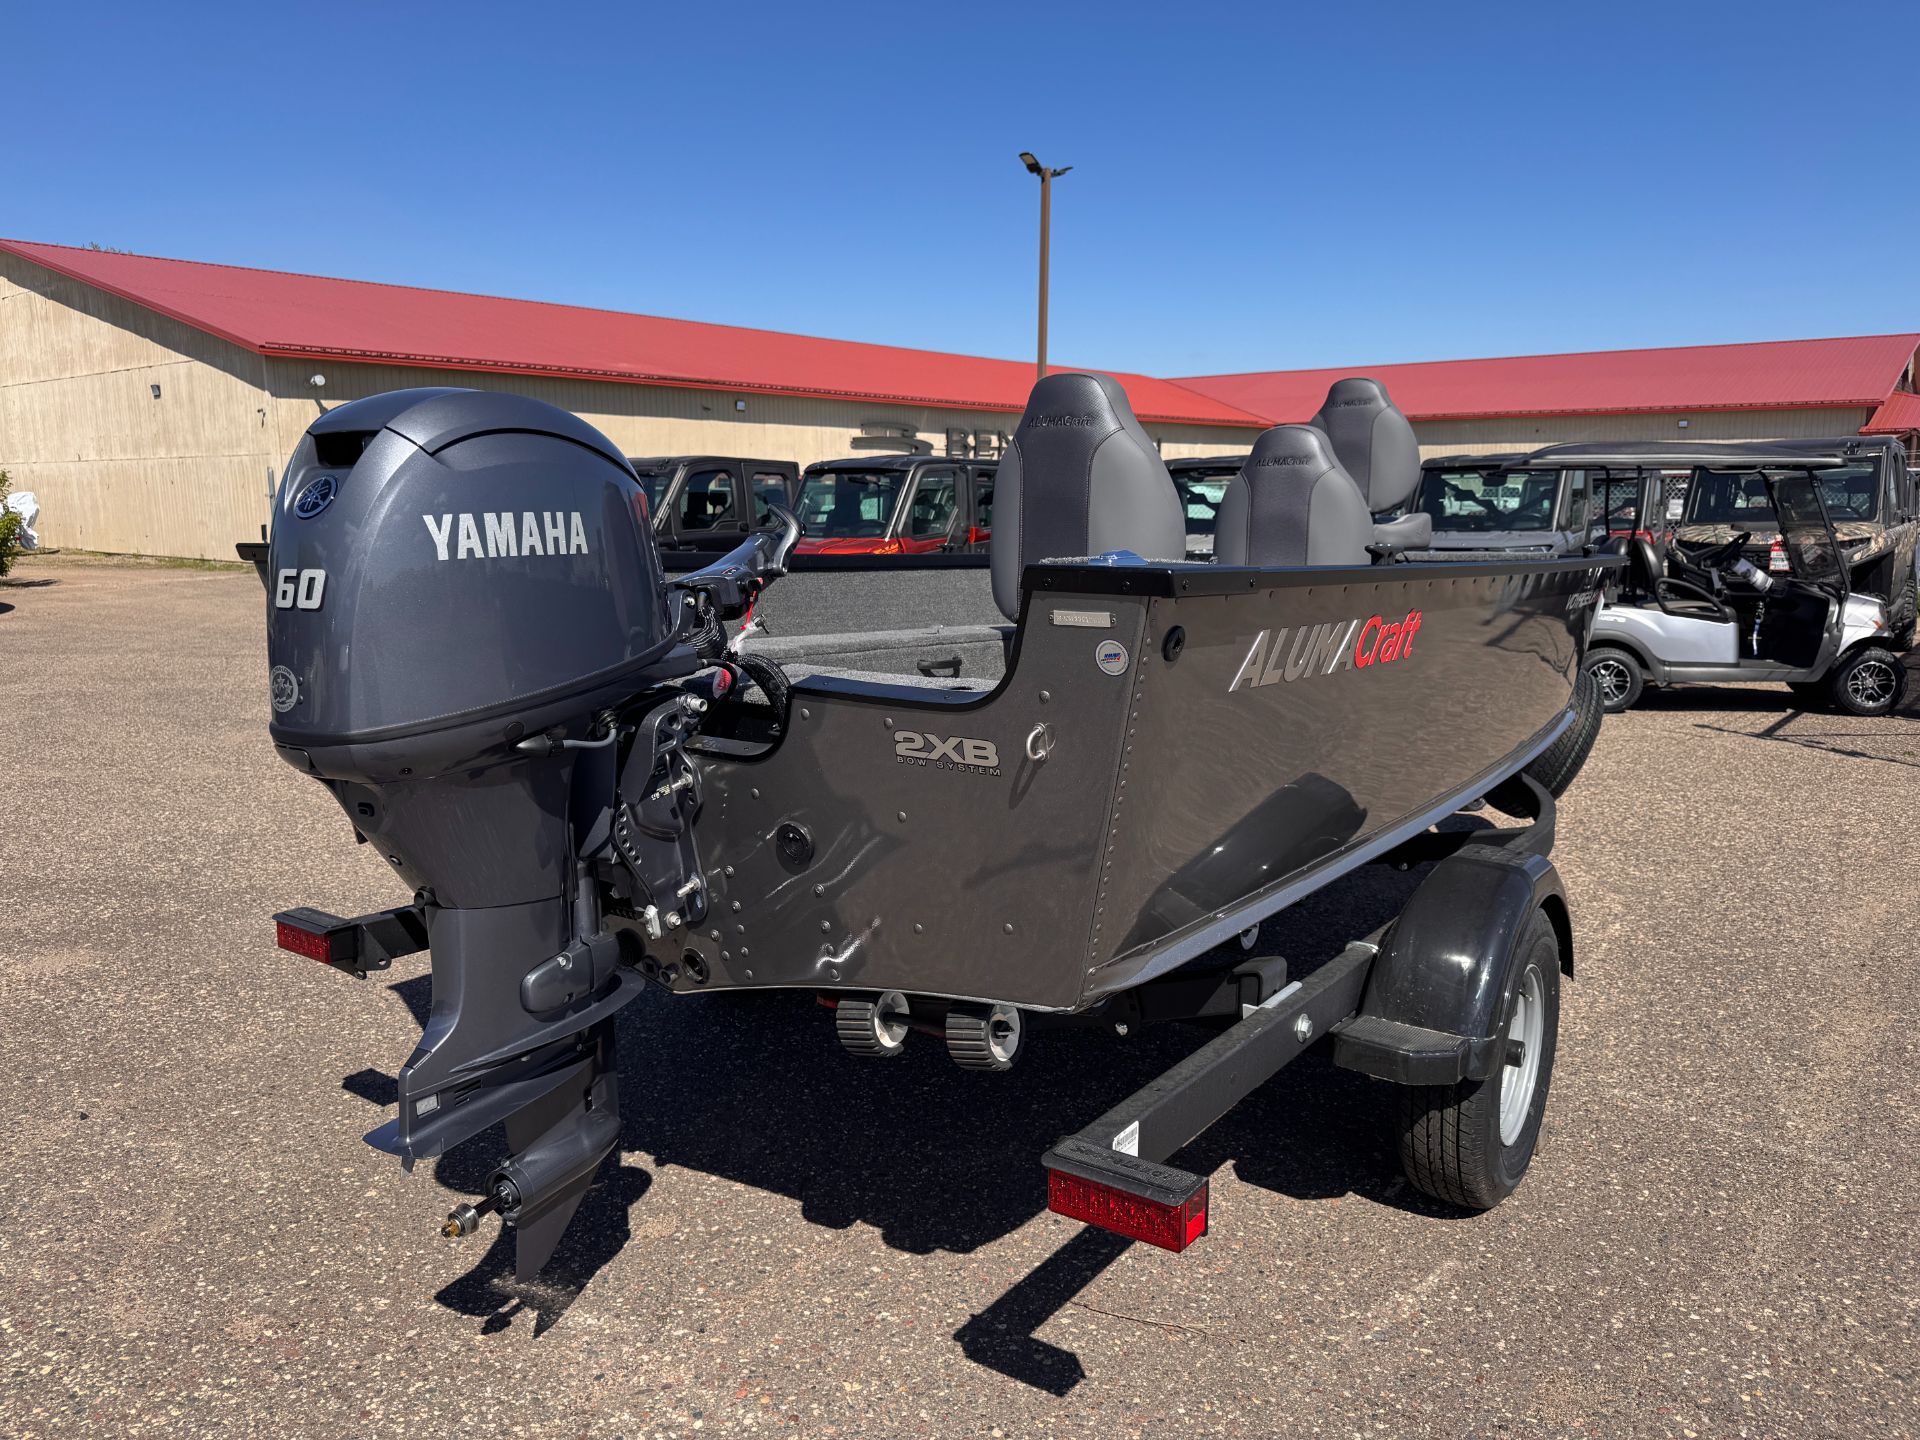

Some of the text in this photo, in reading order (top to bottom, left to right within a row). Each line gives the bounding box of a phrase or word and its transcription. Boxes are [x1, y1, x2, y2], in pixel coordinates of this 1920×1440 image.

[422, 511, 589, 561] YAMAHA
[275, 568, 326, 610] 60
[1227, 610, 1422, 693] ALUMACraft
[894, 730, 1000, 767] 2XB
[897, 756, 1001, 776] BOW SYSTEM
